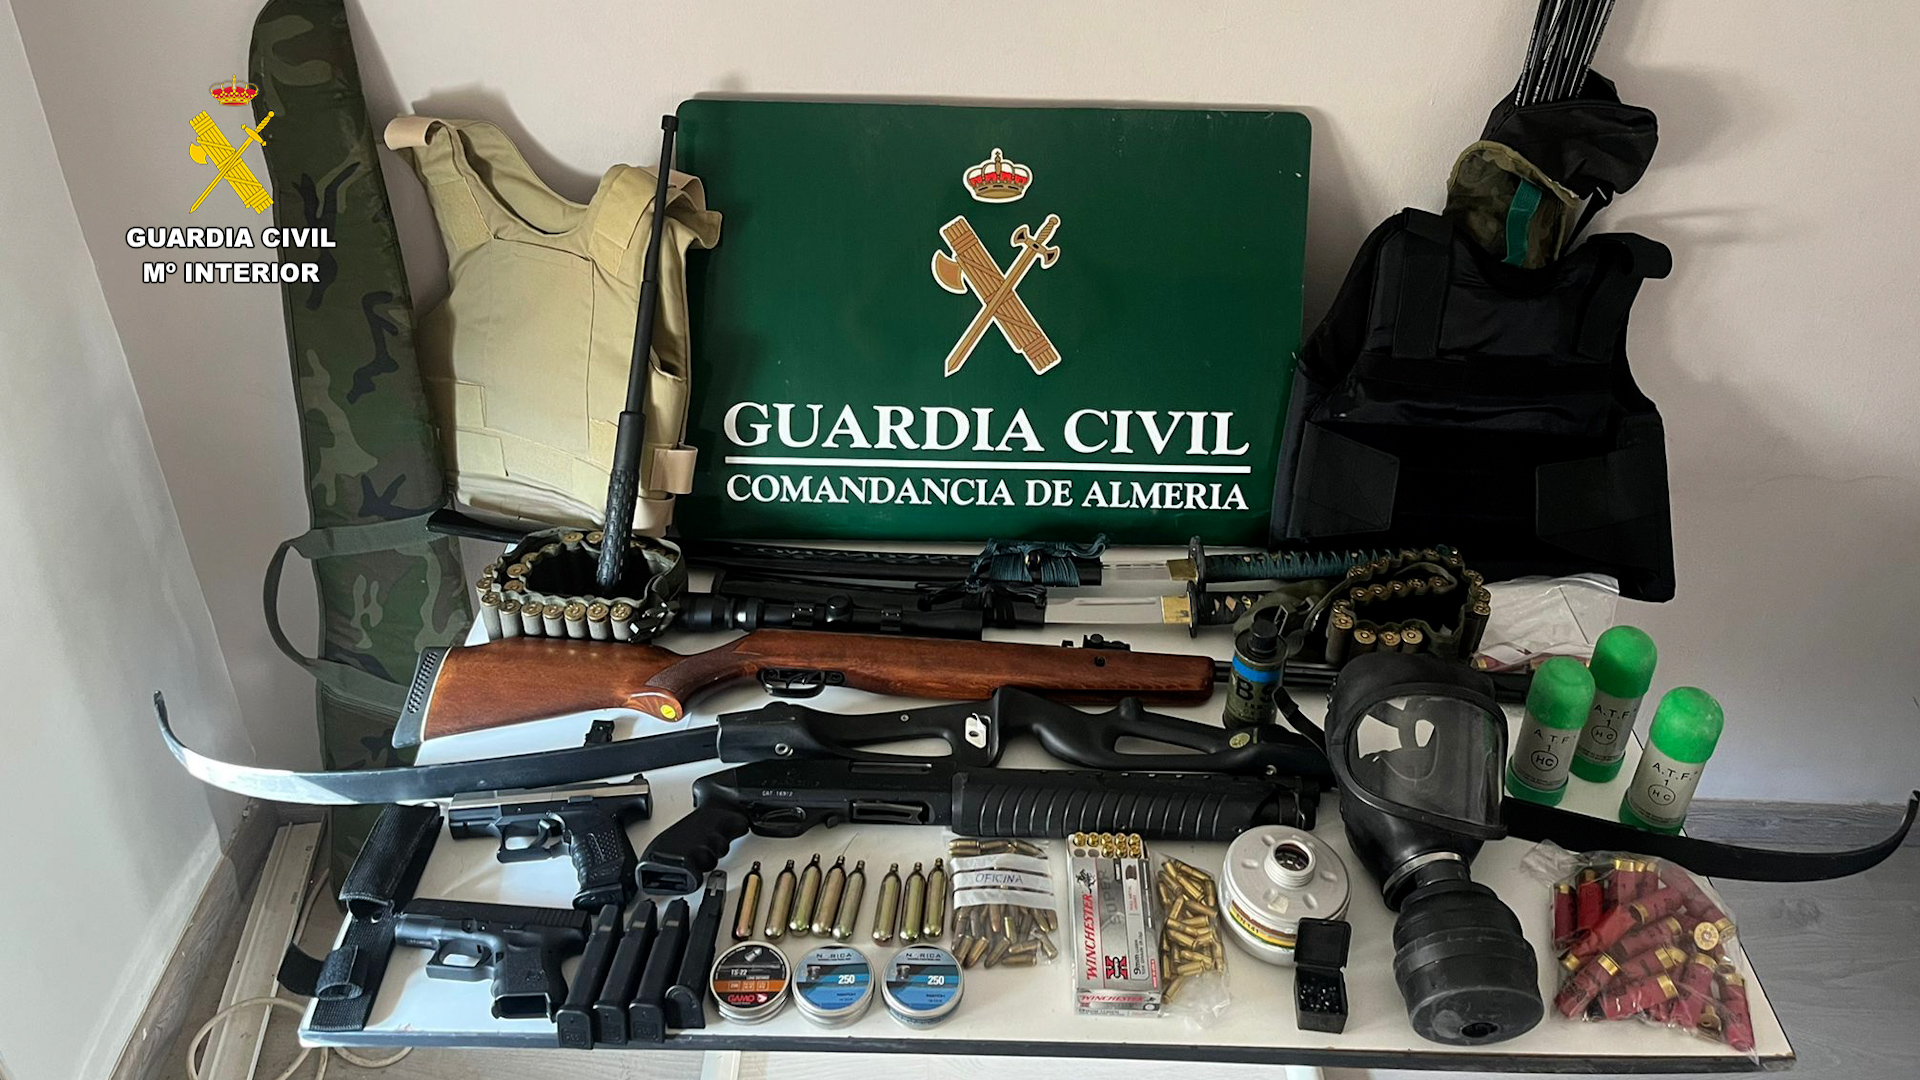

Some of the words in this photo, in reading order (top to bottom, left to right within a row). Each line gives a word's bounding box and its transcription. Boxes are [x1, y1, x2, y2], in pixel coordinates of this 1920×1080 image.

[723, 401, 1045, 453] GUARDIA
[1064, 408, 1250, 456] CIVIL
[726, 474, 1015, 506] COMANDANCIA
[1025, 479, 1073, 507] DE
[1081, 481, 1249, 510] ALMERIA
[1236, 677, 1254, 701] B
[975, 873, 1023, 884] OFICINA
[1098, 869, 1122, 926] SUPER
[1082, 893, 1098, 980] WINCHESTER
[1134, 954, 1142, 975] 9mm
[838, 974, 855, 985] 250
[927, 975, 945, 986] 250
[727, 994, 755, 1003] GAMO
[1081, 995, 1145, 1003] WINCHESTER
